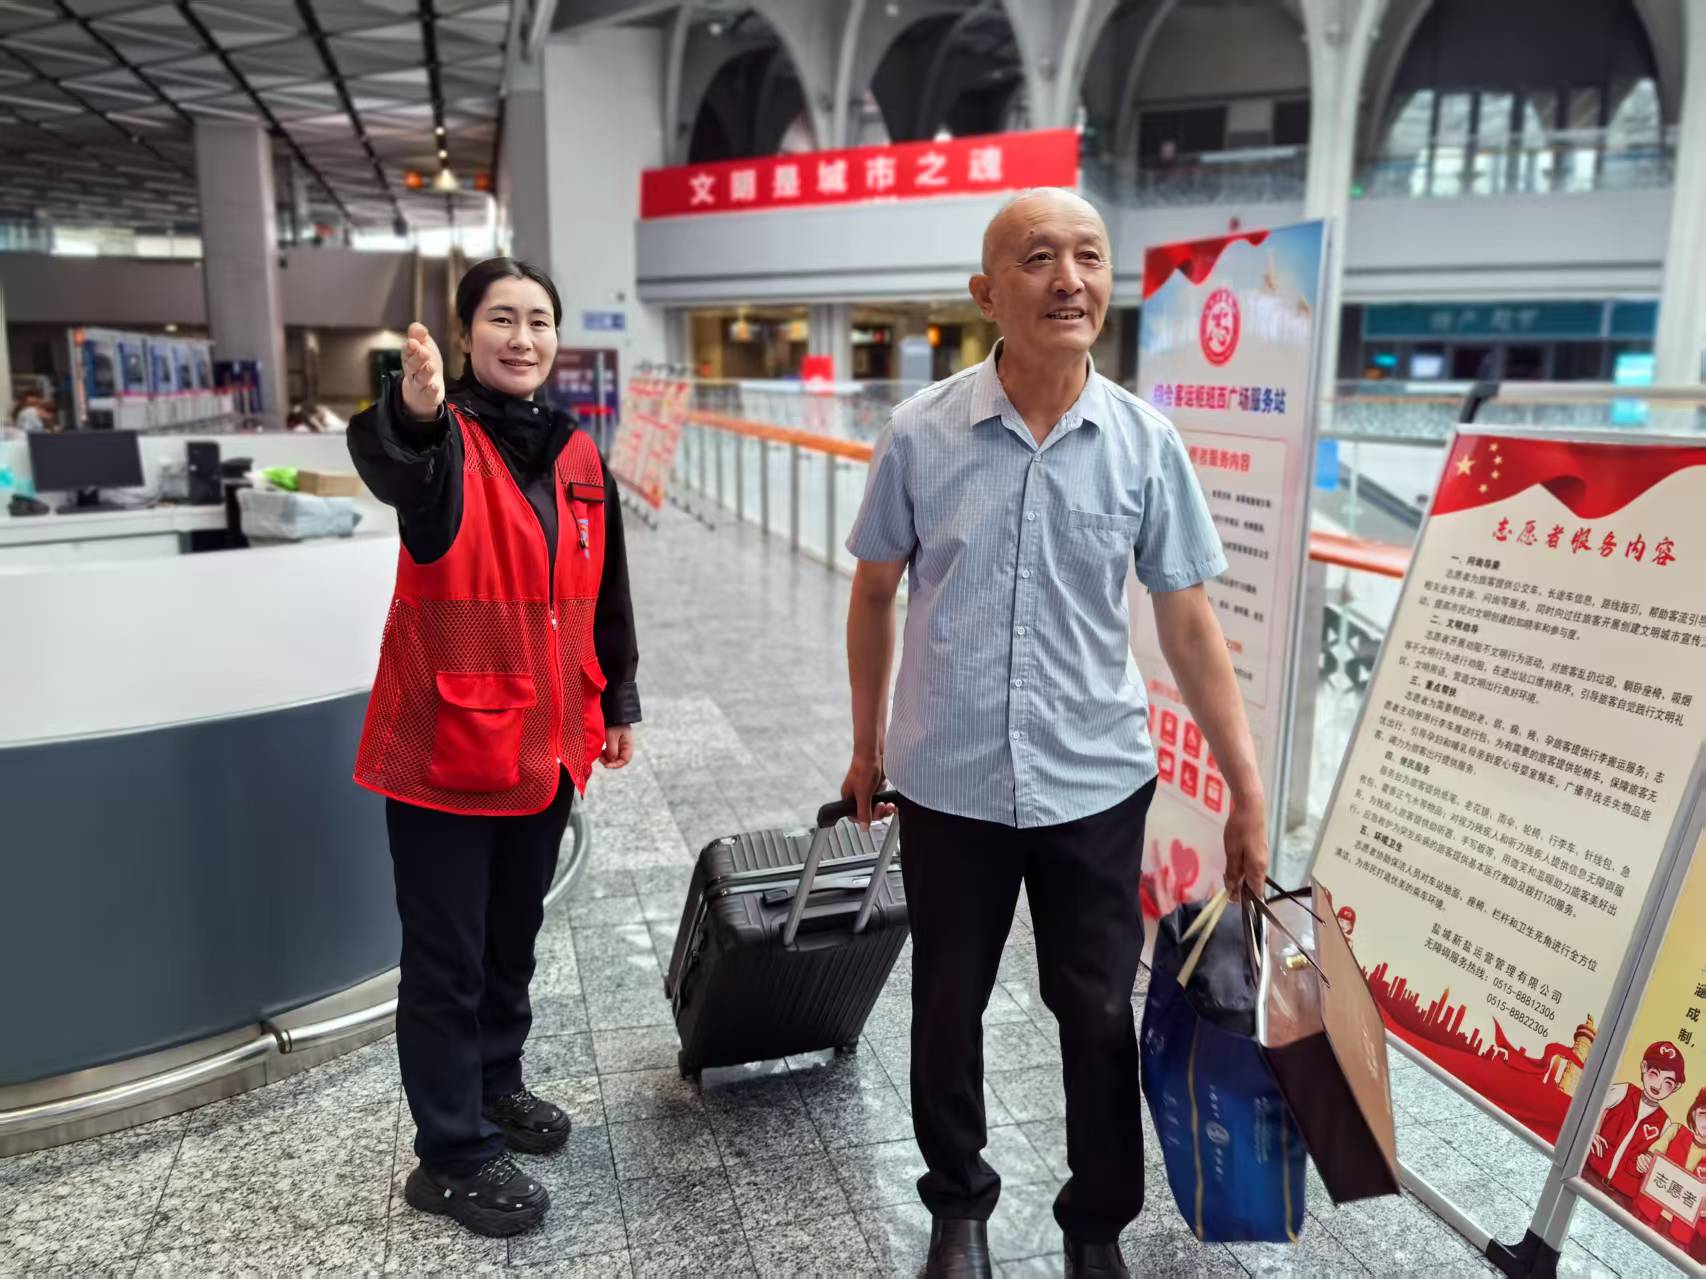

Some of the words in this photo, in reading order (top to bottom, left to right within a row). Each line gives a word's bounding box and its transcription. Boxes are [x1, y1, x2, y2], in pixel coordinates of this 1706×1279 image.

[690, 146, 1003, 205] 文明是城市之魂
[1492, 516, 1677, 567] 志愿者服务内容
[1360, 825, 1403, 853] 五、环境卫生
[1431, 922, 1562, 1004] 盐城新盐运营管理有限公司
[1486, 993, 1549, 1037] 0515-88822306
[1686, 1007, 1701, 1023] 成
[1653, 1169, 1697, 1208] 志愿者
